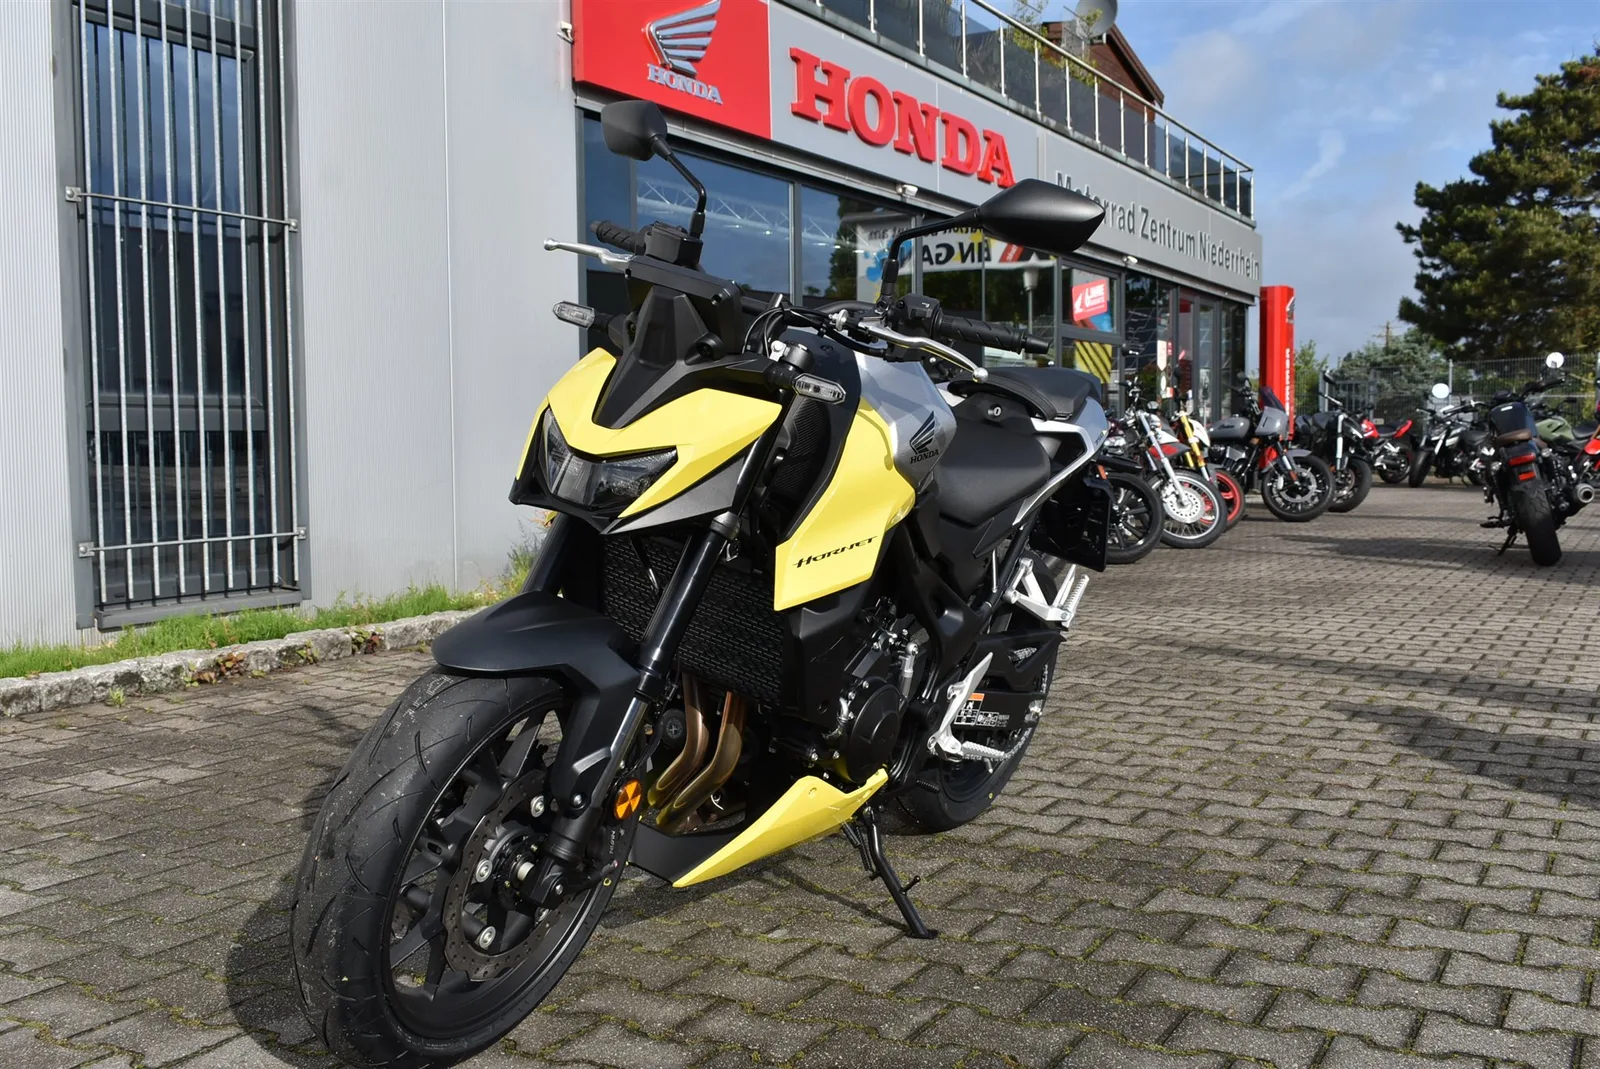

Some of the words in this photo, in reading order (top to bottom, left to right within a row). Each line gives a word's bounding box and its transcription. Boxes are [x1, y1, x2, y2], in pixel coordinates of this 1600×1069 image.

[647, 63, 723, 104] HONDA
[789, 47, 1016, 188] HONDA
[1140, 206, 1195, 257] Zentrum
[1199, 231, 1259, 280] Niederrhein
[910, 449, 939, 464] HONDA
